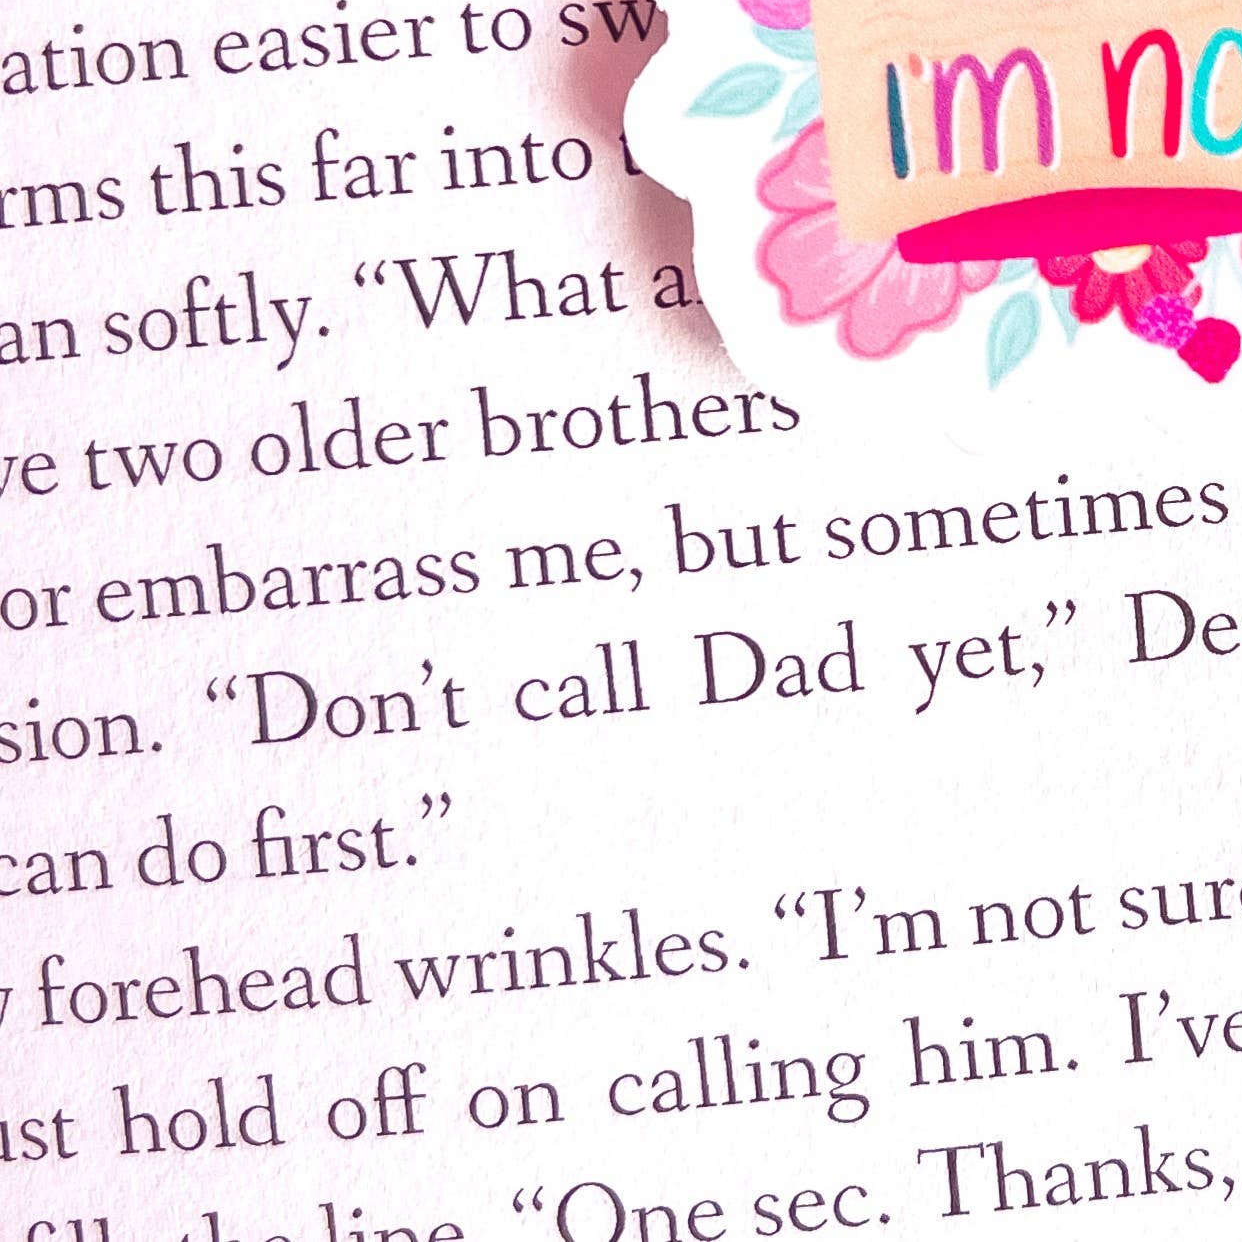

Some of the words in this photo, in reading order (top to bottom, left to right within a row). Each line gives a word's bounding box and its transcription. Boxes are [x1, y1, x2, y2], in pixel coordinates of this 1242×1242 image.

[2, 24, 188, 94] ation
[214, 0, 434, 74] easier
[461, 4, 531, 53] to
[151, 142, 285, 215] this
[312, 128, 416, 201] far
[441, 126, 592, 190] into
[105, 271, 329, 371] softly.
[355, 250, 628, 328] “What
[85, 440, 221, 490] two
[251, 397, 448, 475] older
[471, 373, 799, 456] brothers
[0, 585, 70, 630] or
[97, 543, 479, 622] embarrass
[506, 539, 642, 592] me,
[665, 504, 801, 573] but
[826, 474, 1228, 559] sometimes
[0, 698, 162, 763] sion.
[207, 660, 469, 744] “Don’t
[515, 640, 650, 721] call
[694, 620, 864, 704] Dad
[909, 600, 1076, 714] yet,”
[0, 850, 113, 896] can
[138, 813, 226, 886] do
[252, 792, 451, 877] first.”
[39, 933, 371, 1025] forehead
[394, 909, 748, 999] wrinkles.
[775, 887, 947, 960] “I’m
[969, 885, 1095, 944] not
[113, 1074, 285, 1154] hold
[328, 1063, 426, 1139] off
[469, 1083, 564, 1128] on
[609, 1035, 869, 1123] calling
[903, 1017, 1078, 1086] him.
[513, 1182, 726, 1242] “One
[754, 1186, 890, 1236] sec.
[918, 1125, 1234, 1217] Thanks,
